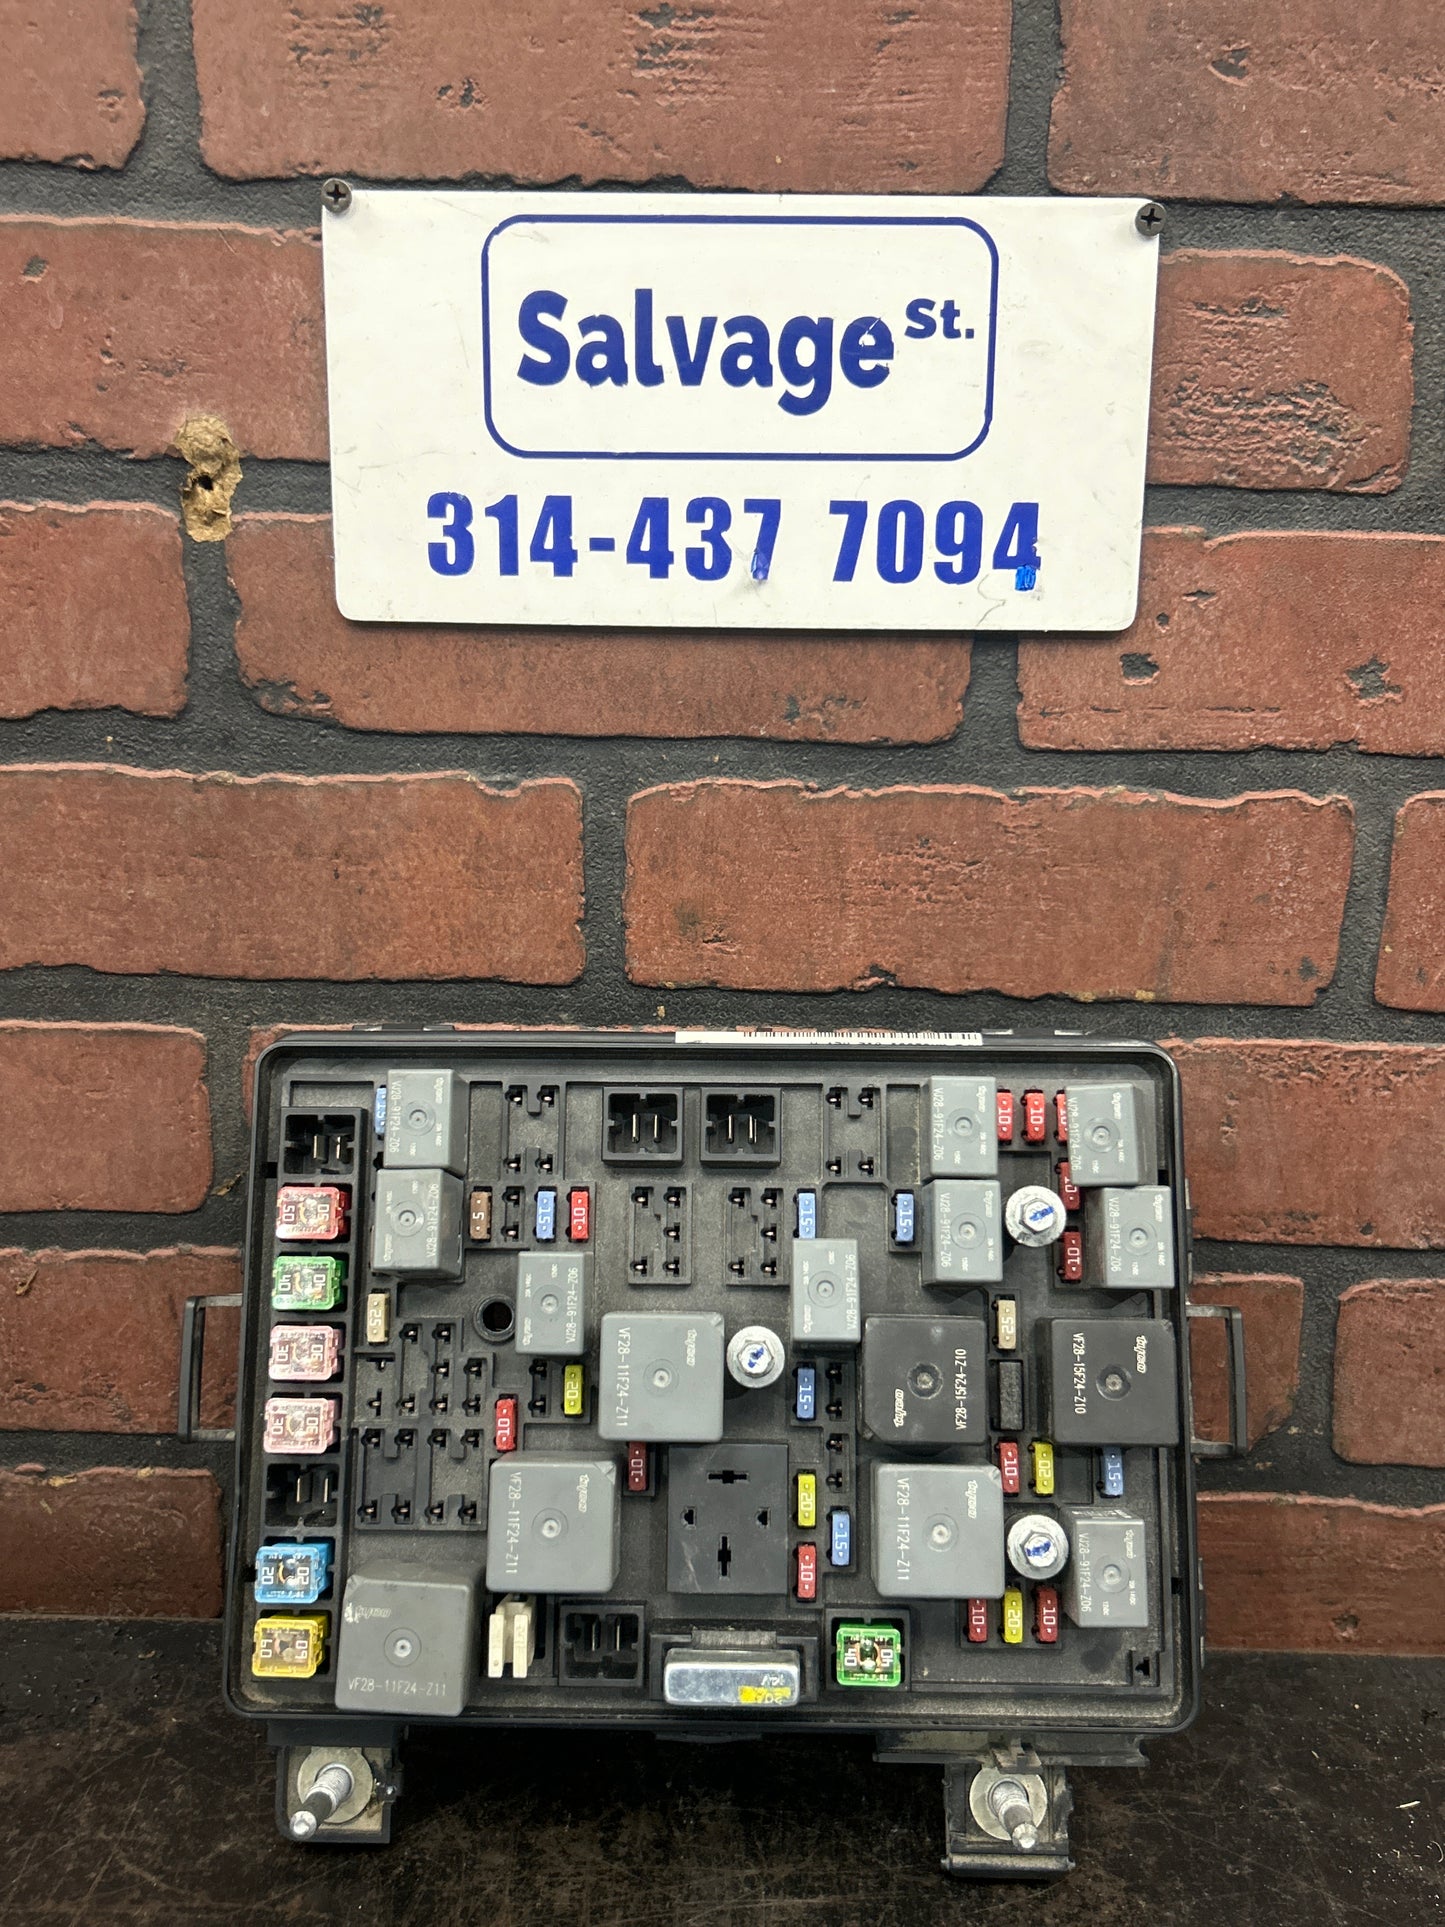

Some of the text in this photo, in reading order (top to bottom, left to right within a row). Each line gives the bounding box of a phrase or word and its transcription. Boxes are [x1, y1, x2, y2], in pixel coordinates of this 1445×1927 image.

[516, 288, 975, 415] Salvage St.
[426, 492, 1042, 591] 314-437 7094
[376, 1101, 385, 1120] 15
[999, 1108, 1011, 1124] 10
[1031, 1108, 1043, 1124] 10
[283, 1205, 295, 1221] 50
[473, 1212, 484, 1220] 5
[538, 1209, 550, 1224] 15
[574, 1208, 586, 1224] 10
[800, 1209, 812, 1225] 15
[899, 1209, 912, 1226] 15
[1068, 1248, 1081, 1264] 10
[279, 1275, 291, 1291] 40
[314, 1274, 326, 1288] 40
[370, 1309, 382, 1326] 25
[1002, 1317, 1014, 1333] 25
[276, 1345, 289, 1362] 30
[616, 1327, 630, 1426] VF28-11F24-Z11
[1073, 1332, 1087, 1414] VF28-15F24-Z10
[567, 1382, 578, 1398] 20
[800, 1386, 812, 1402] 15
[955, 1348, 967, 1430] VF28-15F24-Z10
[271, 1417, 283, 1434] 30
[498, 1419, 510, 1435] 10
[631, 1459, 643, 1477] 10
[1005, 1458, 1017, 1475] 10
[1039, 1461, 1050, 1478] 20
[1109, 1463, 1121, 1480] 15
[800, 1493, 813, 1511] 20
[505, 1472, 522, 1574] VF28-11F24-Z11
[896, 1477, 910, 1581] VF28-11F24-Z11
[835, 1532, 847, 1549] 15
[262, 1567, 274, 1584] 20
[297, 1567, 309, 1585] 20
[801, 1563, 813, 1581] 10
[972, 1607, 984, 1624] 10
[1008, 1608, 1020, 1627] 20
[1043, 1607, 1056, 1626] 10
[260, 1639, 272, 1658] 60
[295, 1641, 308, 1659] 60
[845, 1648, 857, 1666] 40
[881, 1649, 893, 1667] 40
[349, 1678, 447, 1696] VF28-11F24-Z11
